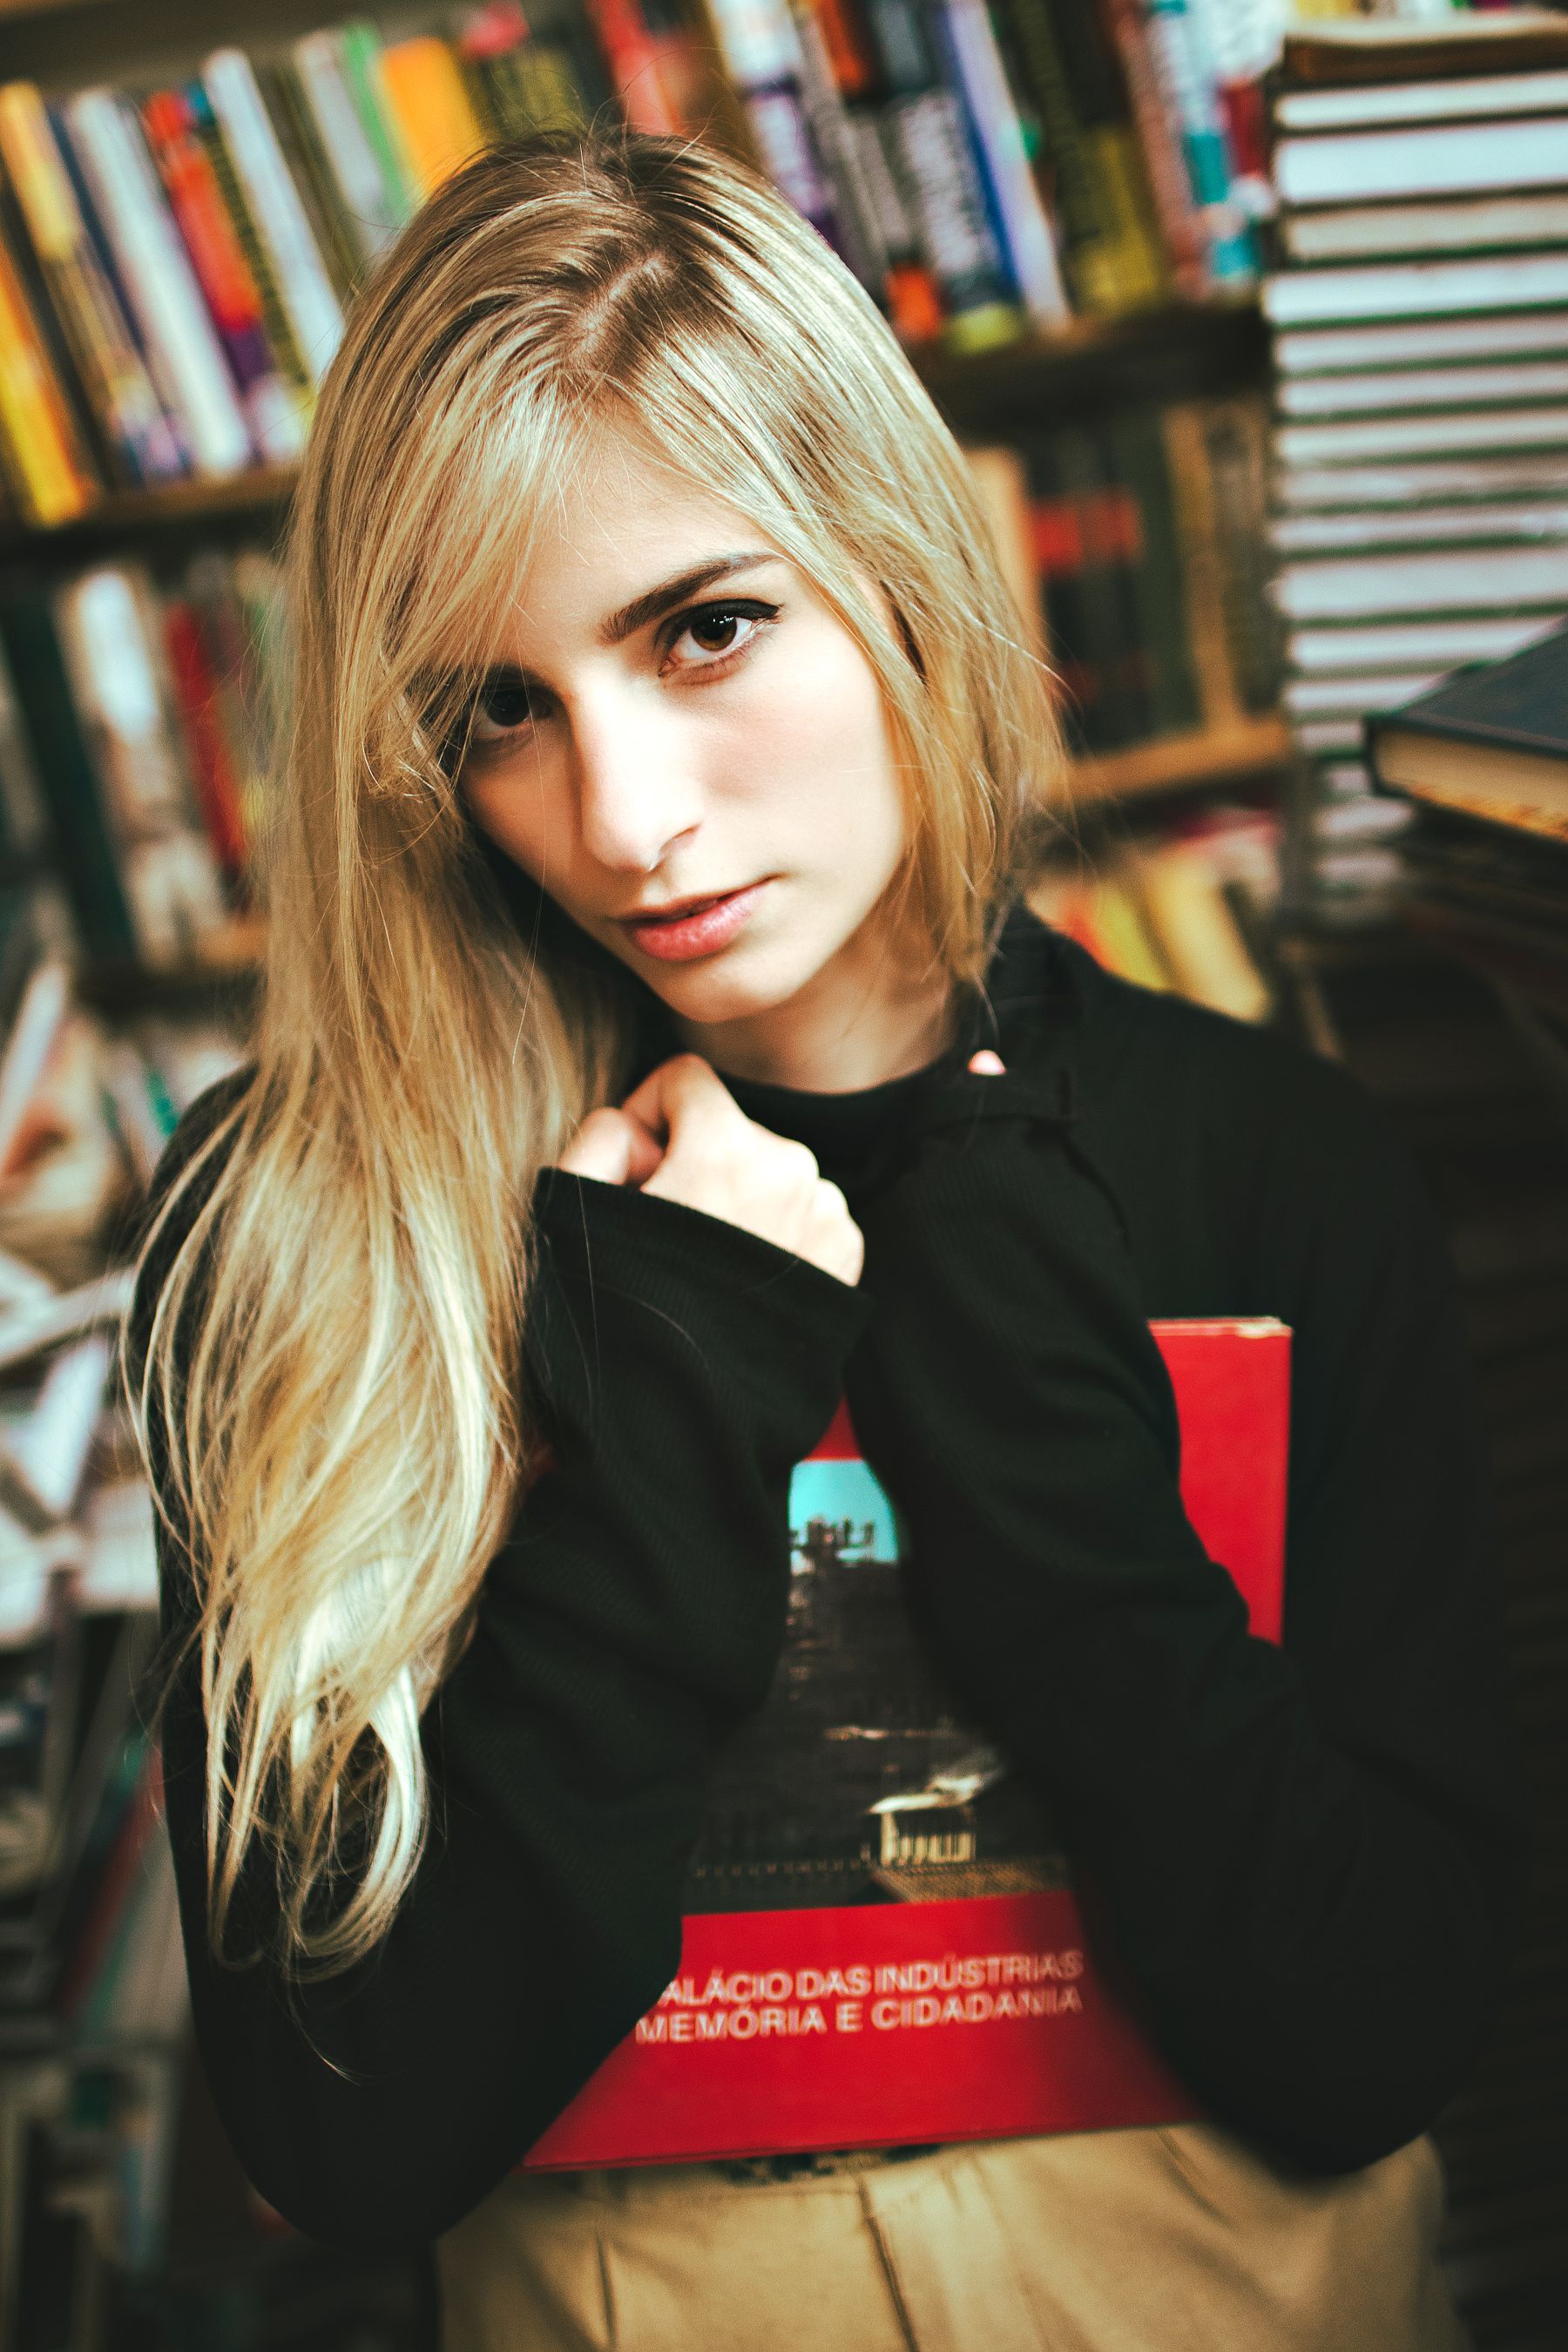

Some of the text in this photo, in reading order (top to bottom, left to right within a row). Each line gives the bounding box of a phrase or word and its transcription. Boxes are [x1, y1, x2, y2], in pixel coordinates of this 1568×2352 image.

[657, 1950, 1084, 2008] ALÁCIO DAS INDÚSTRIAS
[634, 1986, 1084, 2044] MEMÓRIA E CIDADANIA
